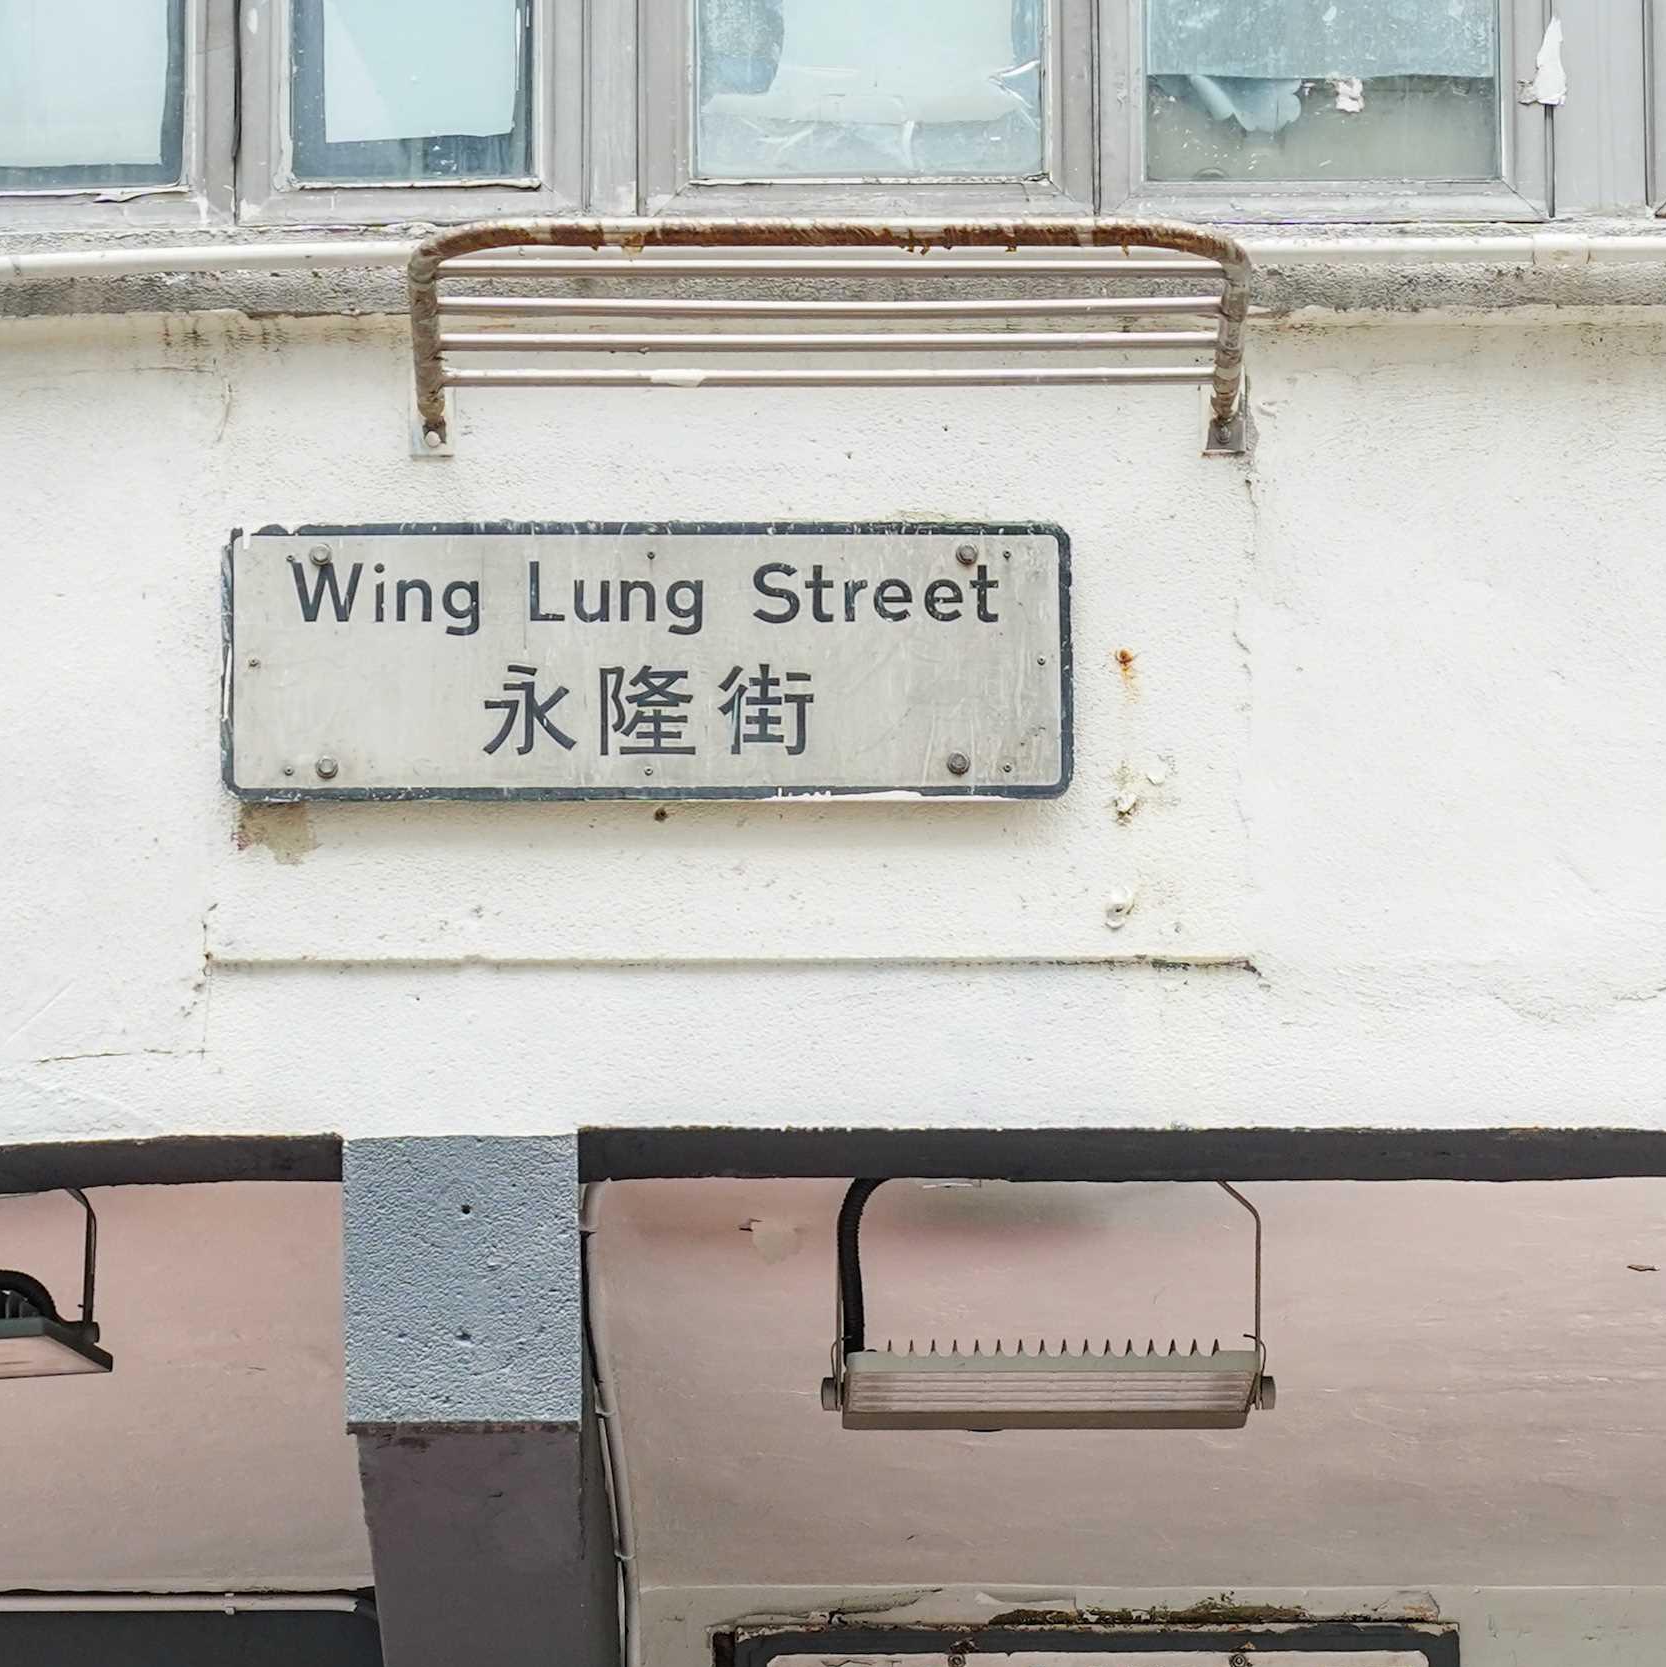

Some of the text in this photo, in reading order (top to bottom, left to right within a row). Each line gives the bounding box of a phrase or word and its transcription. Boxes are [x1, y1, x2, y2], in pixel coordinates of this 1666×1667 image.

[292, 559, 1000, 636] Wing Lung Street
[484, 664, 814, 757] 永隆街
